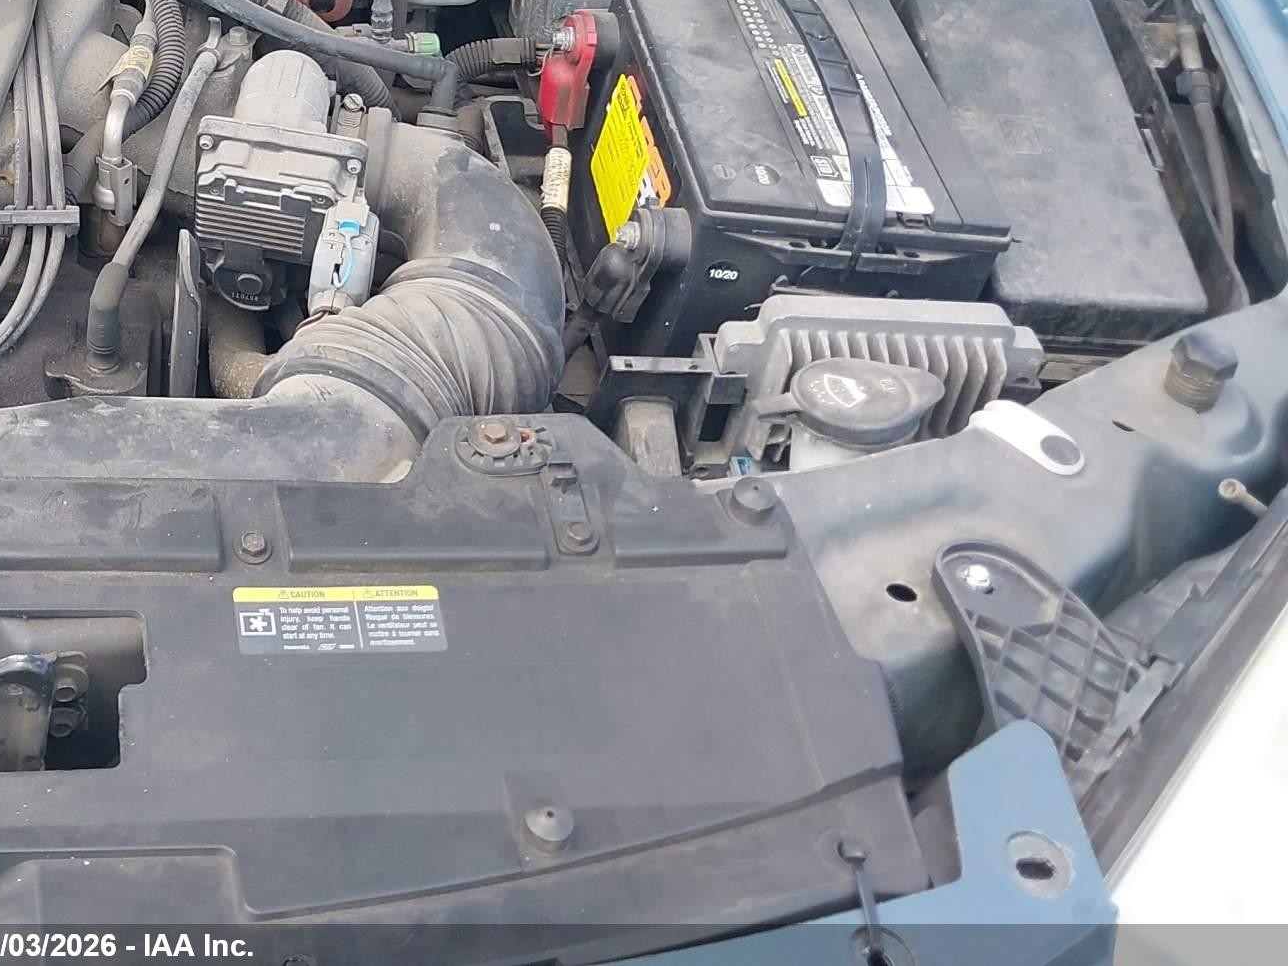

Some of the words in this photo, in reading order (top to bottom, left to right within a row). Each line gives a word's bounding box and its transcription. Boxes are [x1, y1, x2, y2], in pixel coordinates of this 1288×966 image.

[709, 269, 738, 281] 10/20
[290, 590, 325, 598] CAUTION
[375, 589, 418, 597] ATTENTION
